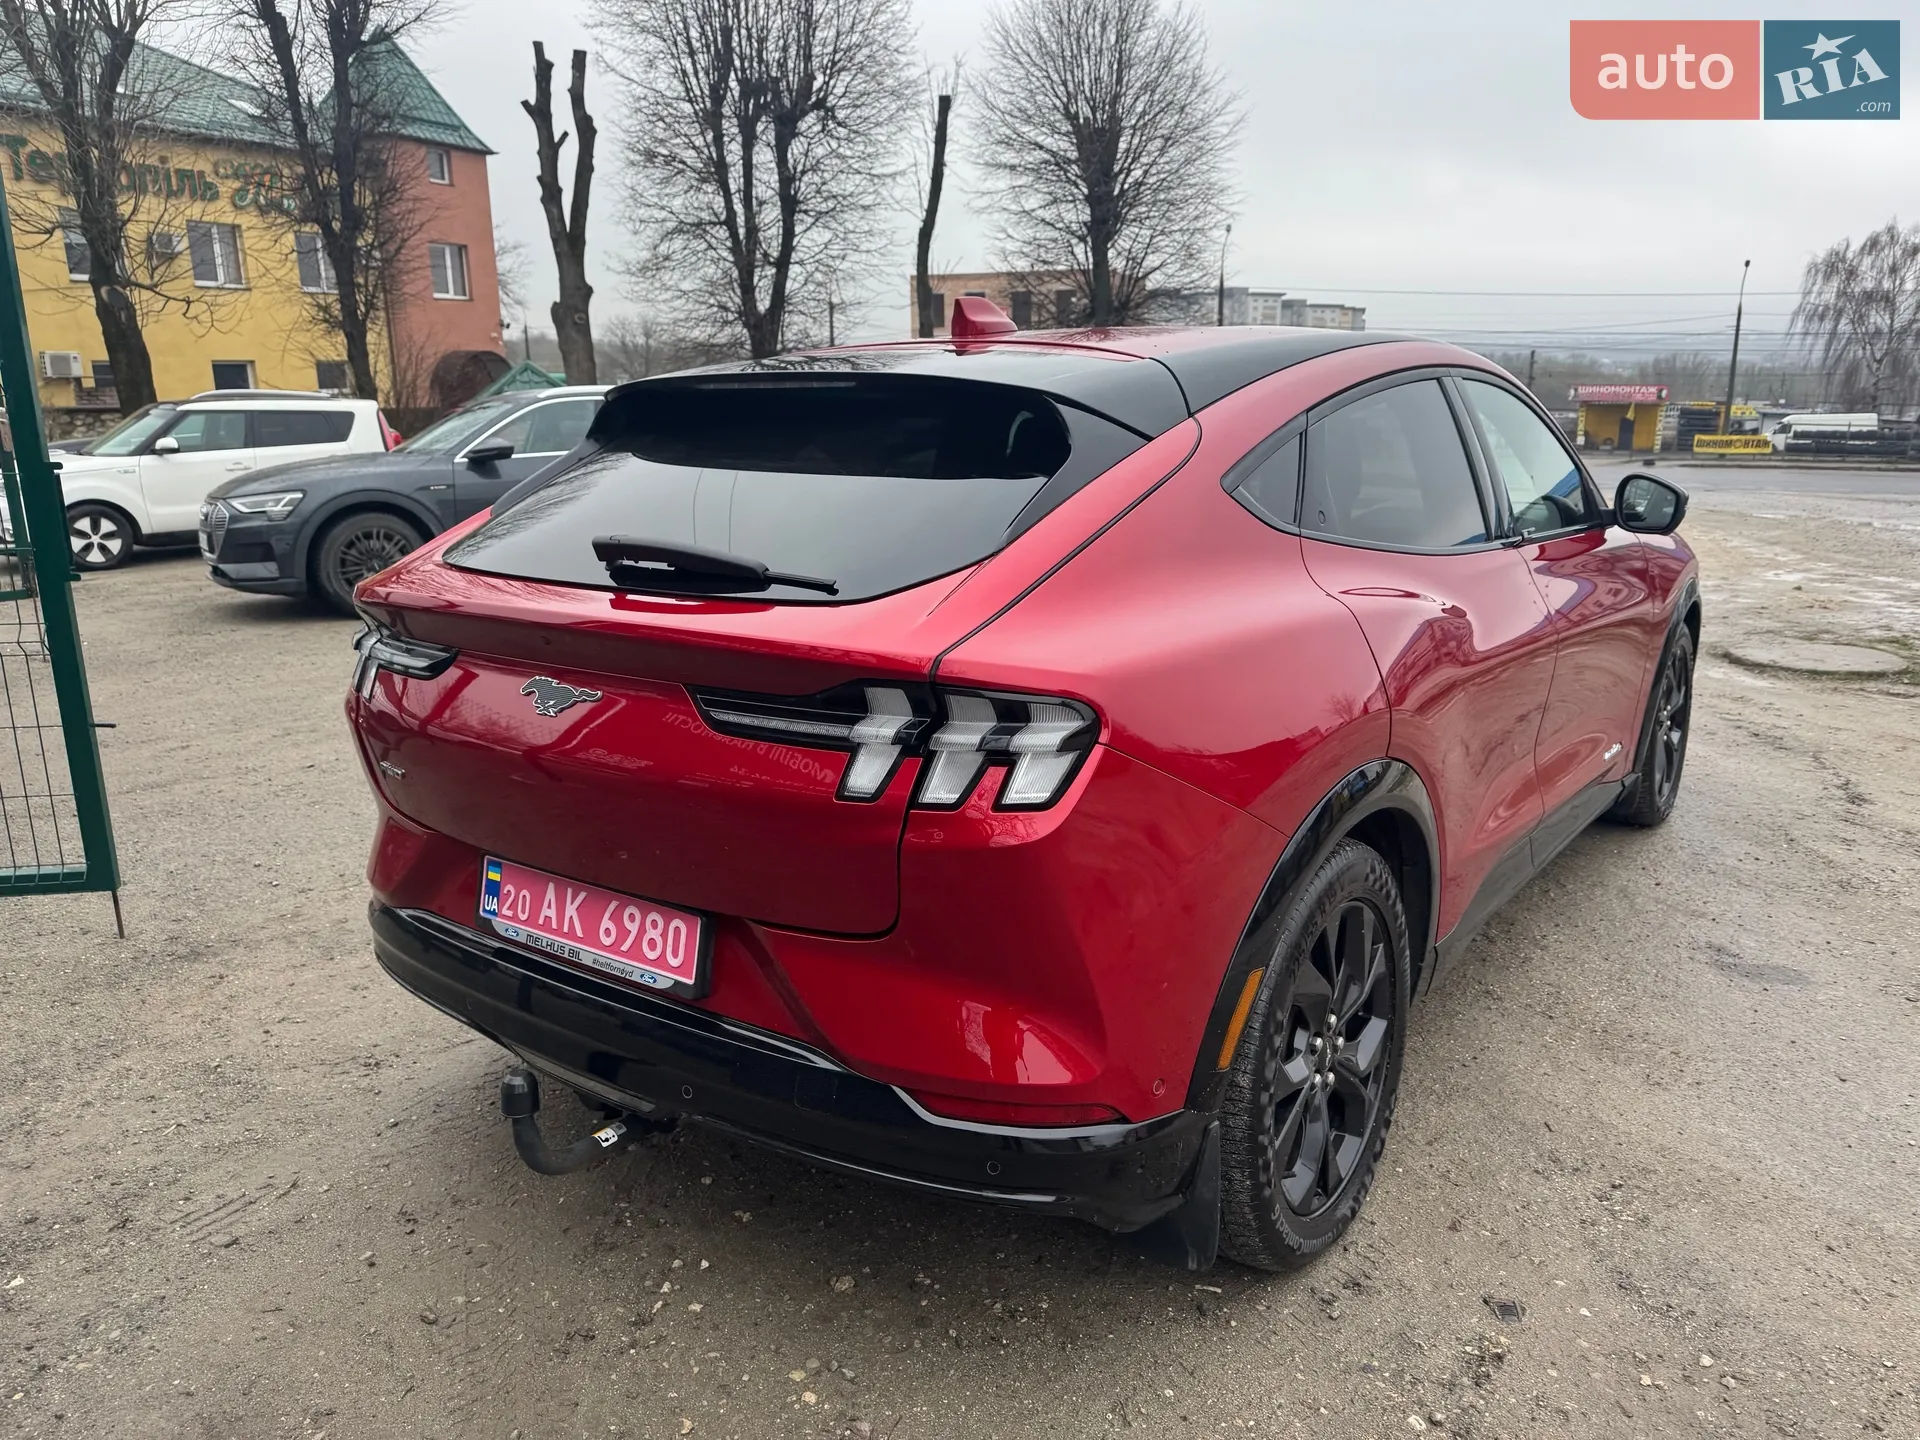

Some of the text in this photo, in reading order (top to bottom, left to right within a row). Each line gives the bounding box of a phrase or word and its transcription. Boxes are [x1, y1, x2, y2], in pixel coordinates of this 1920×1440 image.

[0, 134, 220, 201] Теопіль
[1578, 385, 1658, 394] ШИНОМОНТАЖ
[1695, 438, 1771, 450] ШИНОМОНТАЖ
[484, 894, 498, 914] UA
[501, 882, 688, 969] 20 AK 6980
[526, 933, 583, 962] MELHUS BIL
[1270, 1203, 1281, 1220] 6
